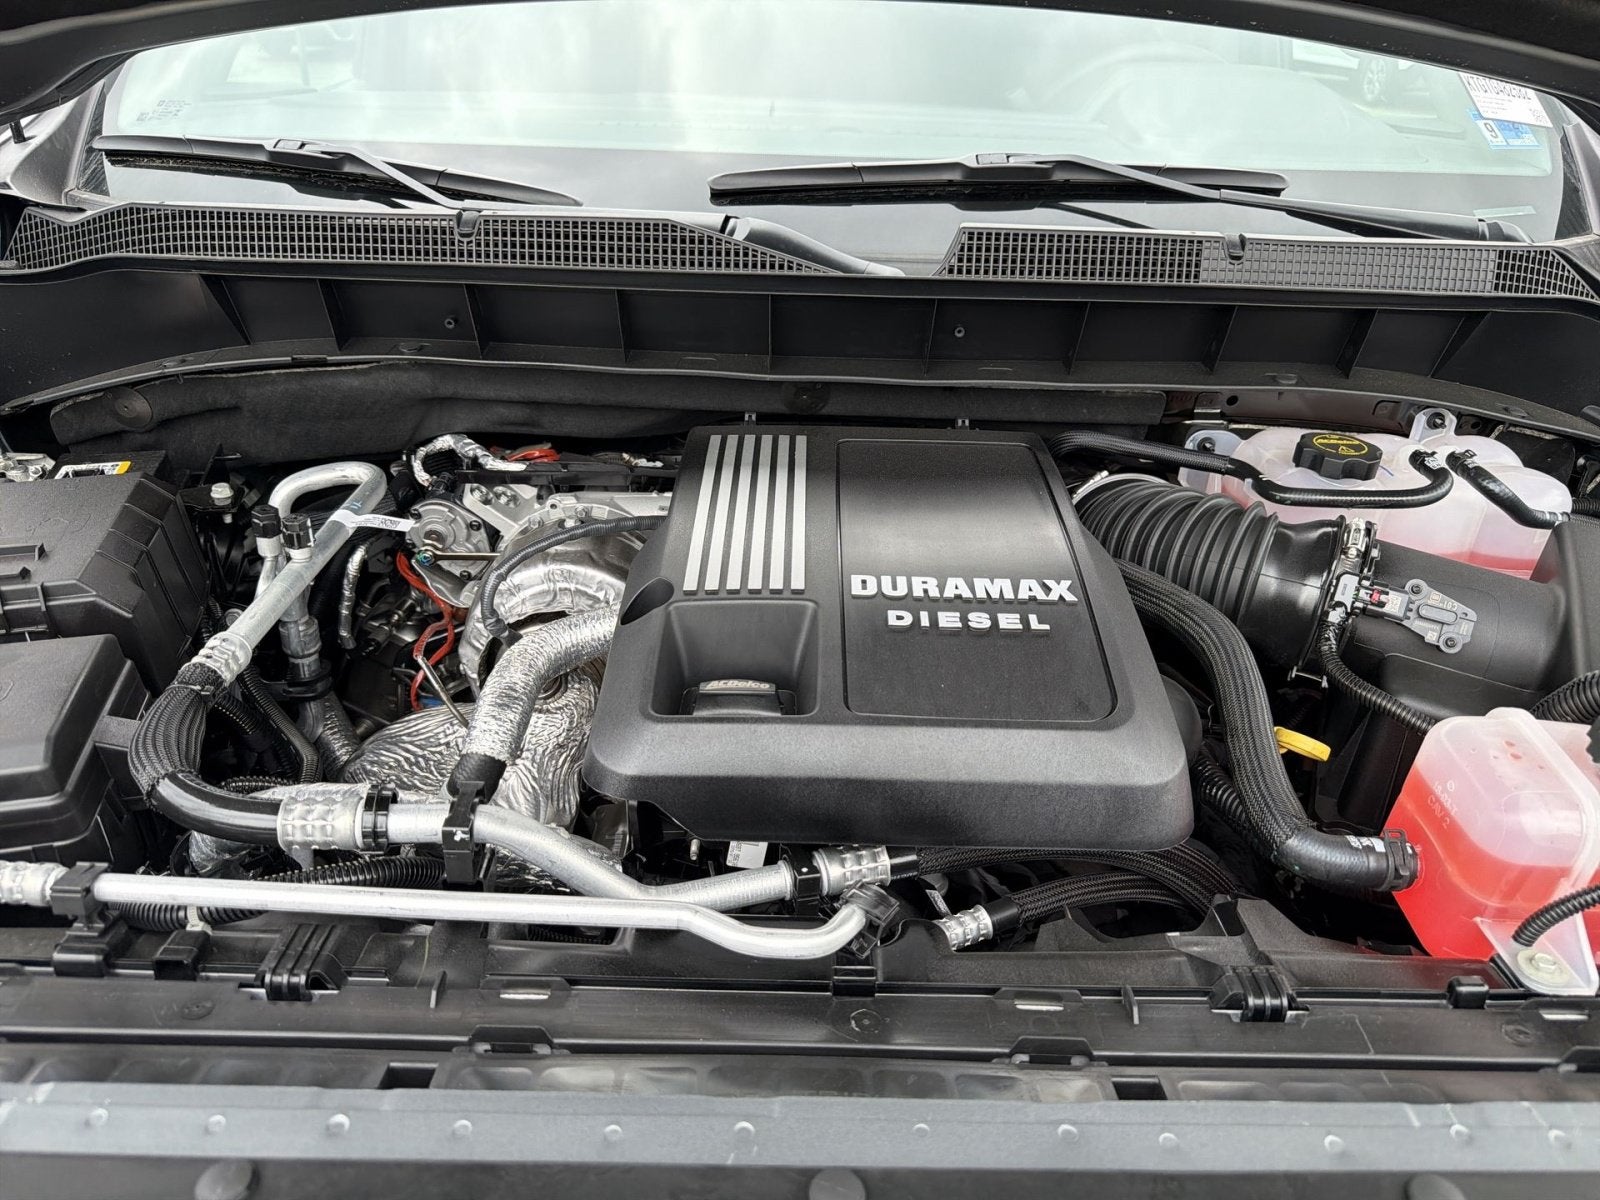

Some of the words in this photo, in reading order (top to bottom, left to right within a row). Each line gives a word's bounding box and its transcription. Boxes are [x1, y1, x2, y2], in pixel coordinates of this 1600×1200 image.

[1484, 122, 1498, 139] 9
[850, 574, 1079, 602] DURAMAX
[887, 609, 1051, 633] DIESEL
[705, 680, 770, 690] ACDelco
